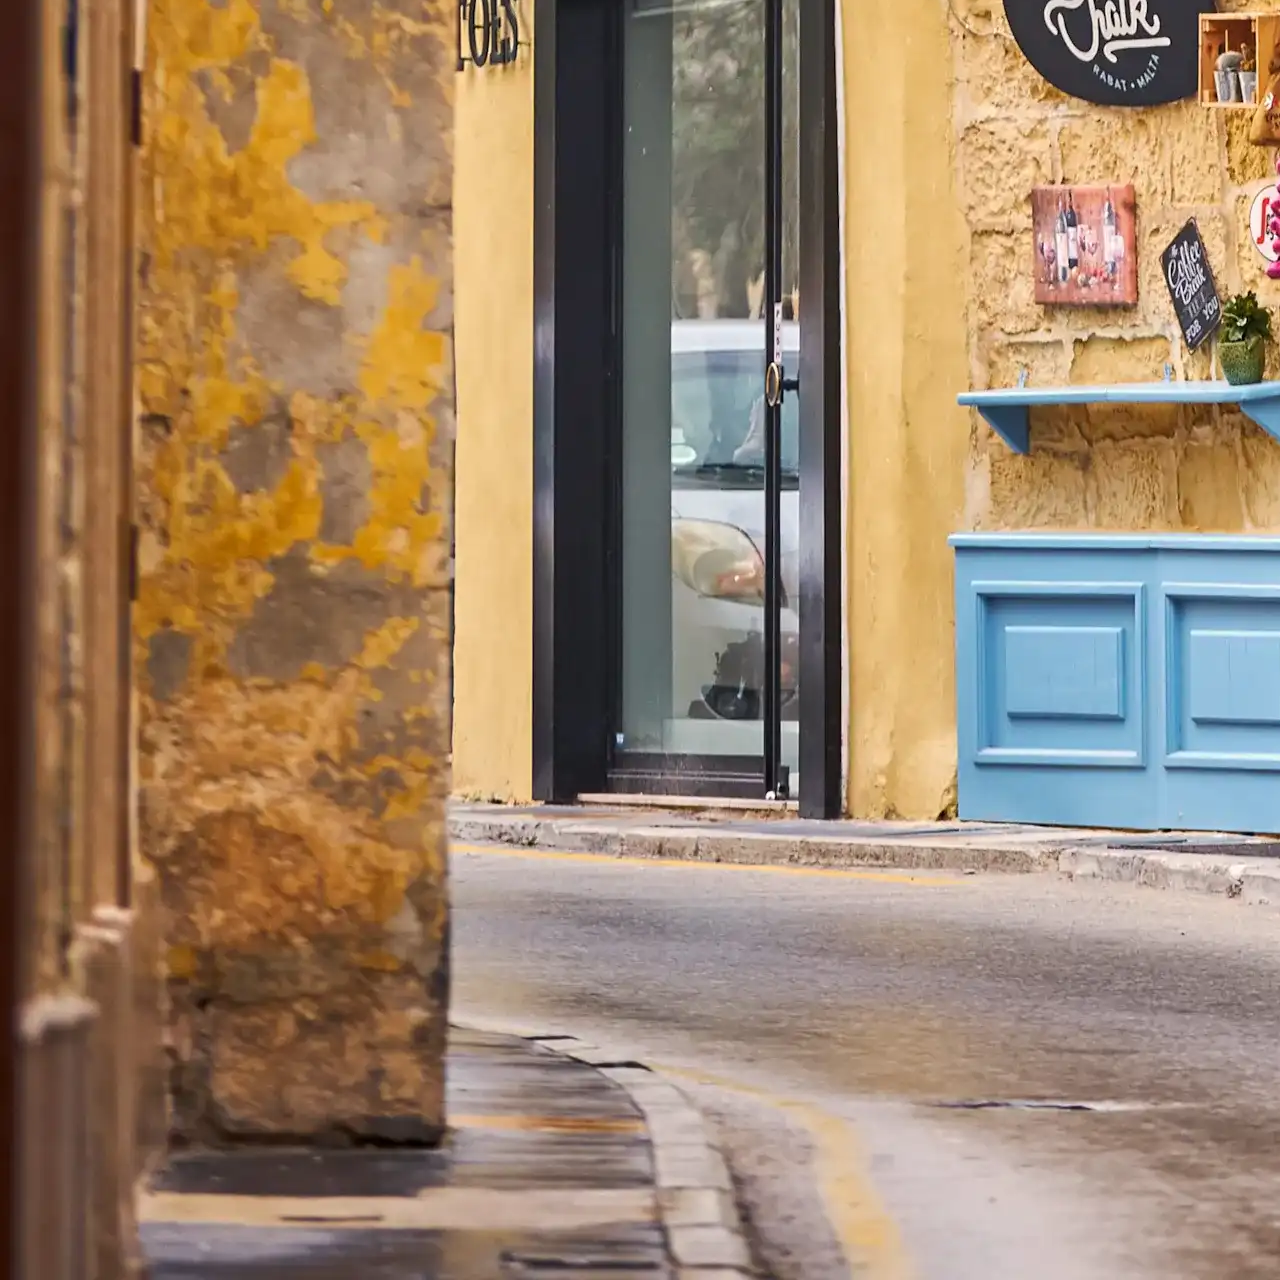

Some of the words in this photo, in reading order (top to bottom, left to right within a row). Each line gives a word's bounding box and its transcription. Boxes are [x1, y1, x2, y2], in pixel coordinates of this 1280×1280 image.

[1093, 64, 1127, 92] RABAT
[1137, 53, 1160, 89] MALTA
[1168, 240, 1201, 289] Coffee
[1175, 263, 1206, 305] Break
[1186, 320, 1202, 343] FOR
[1203, 296, 1219, 320] YOU
